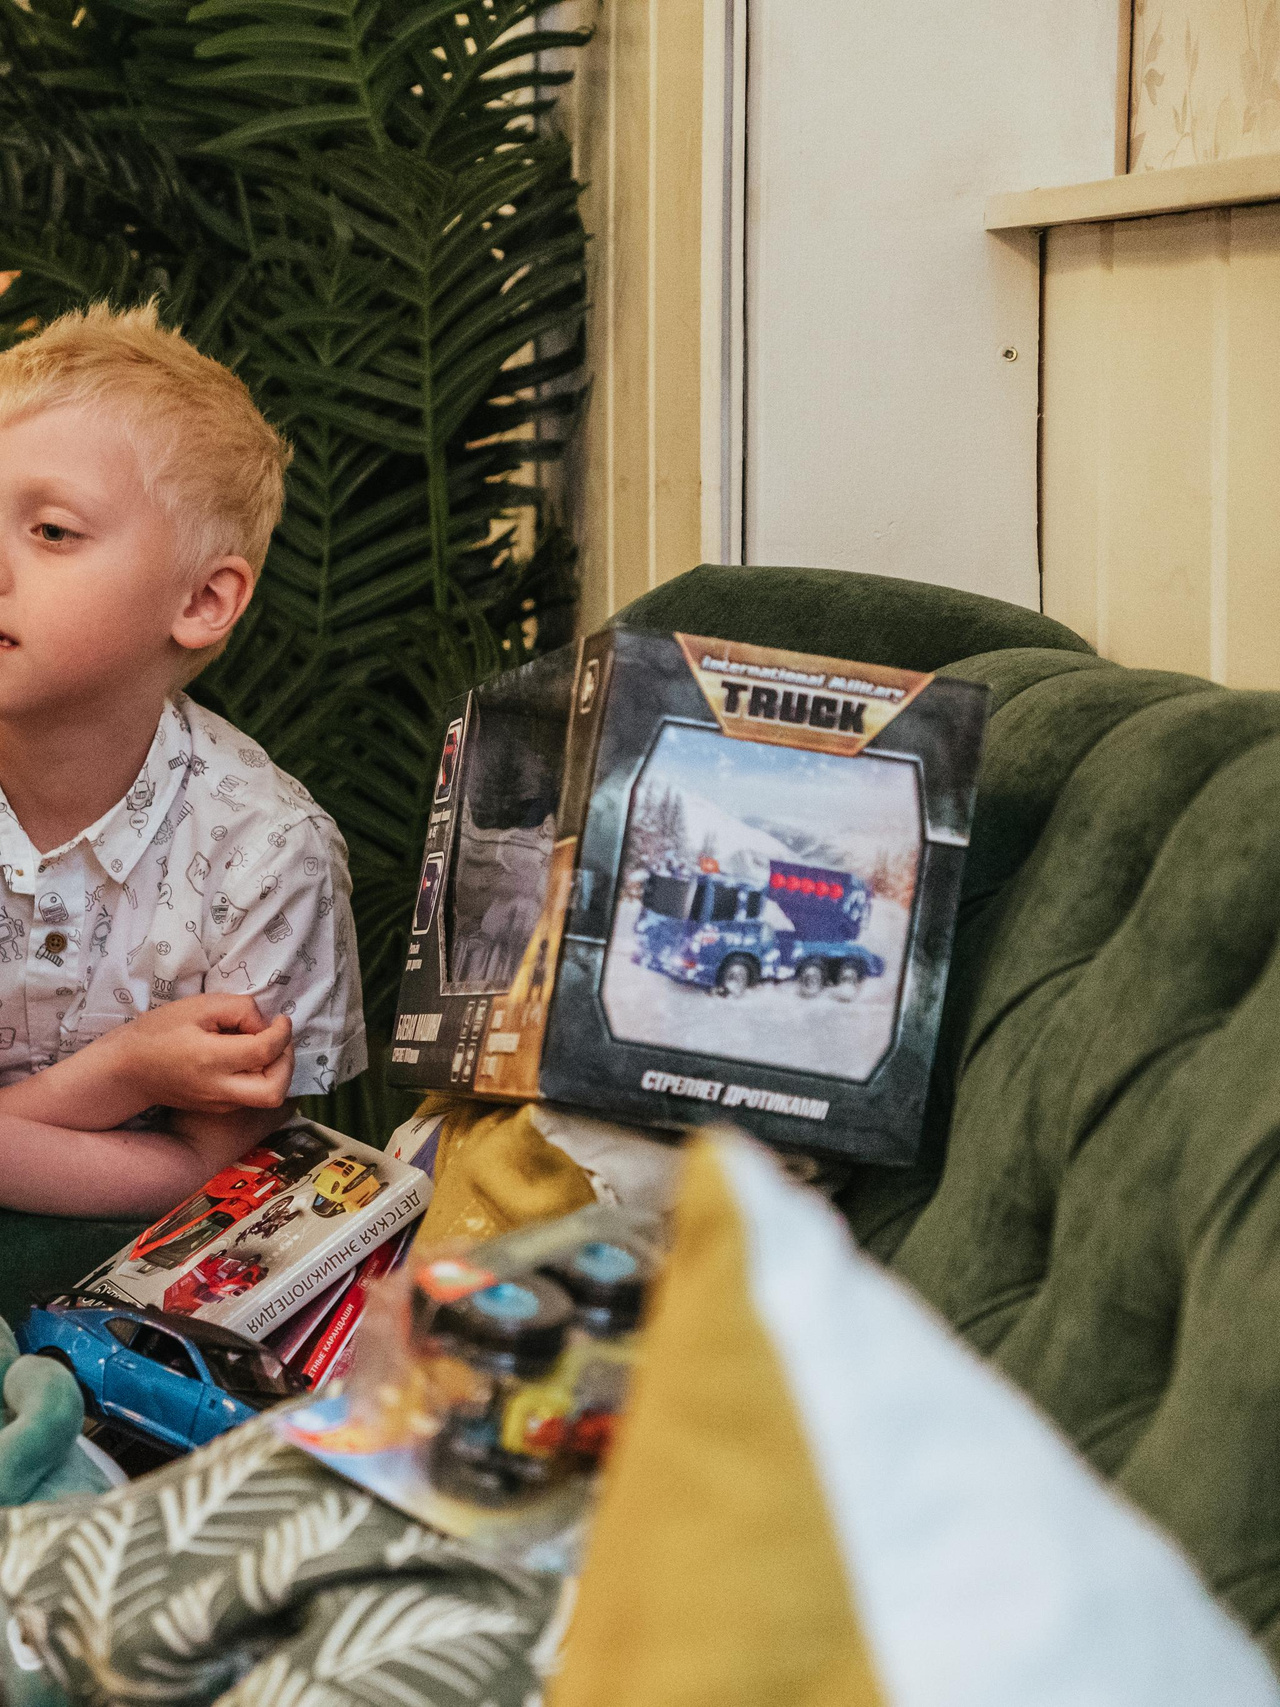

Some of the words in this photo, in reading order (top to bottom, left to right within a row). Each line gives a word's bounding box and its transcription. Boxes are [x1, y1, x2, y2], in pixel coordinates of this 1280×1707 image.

[721, 680, 868, 735] TRUCK
[362, 1188, 421, 1246] ДЕТСКАЯ
[245, 1243, 362, 1335] ЭНЦИКЛОПЕДИЯ
[324, 1303, 355, 1353] КАРАНДАШИ
